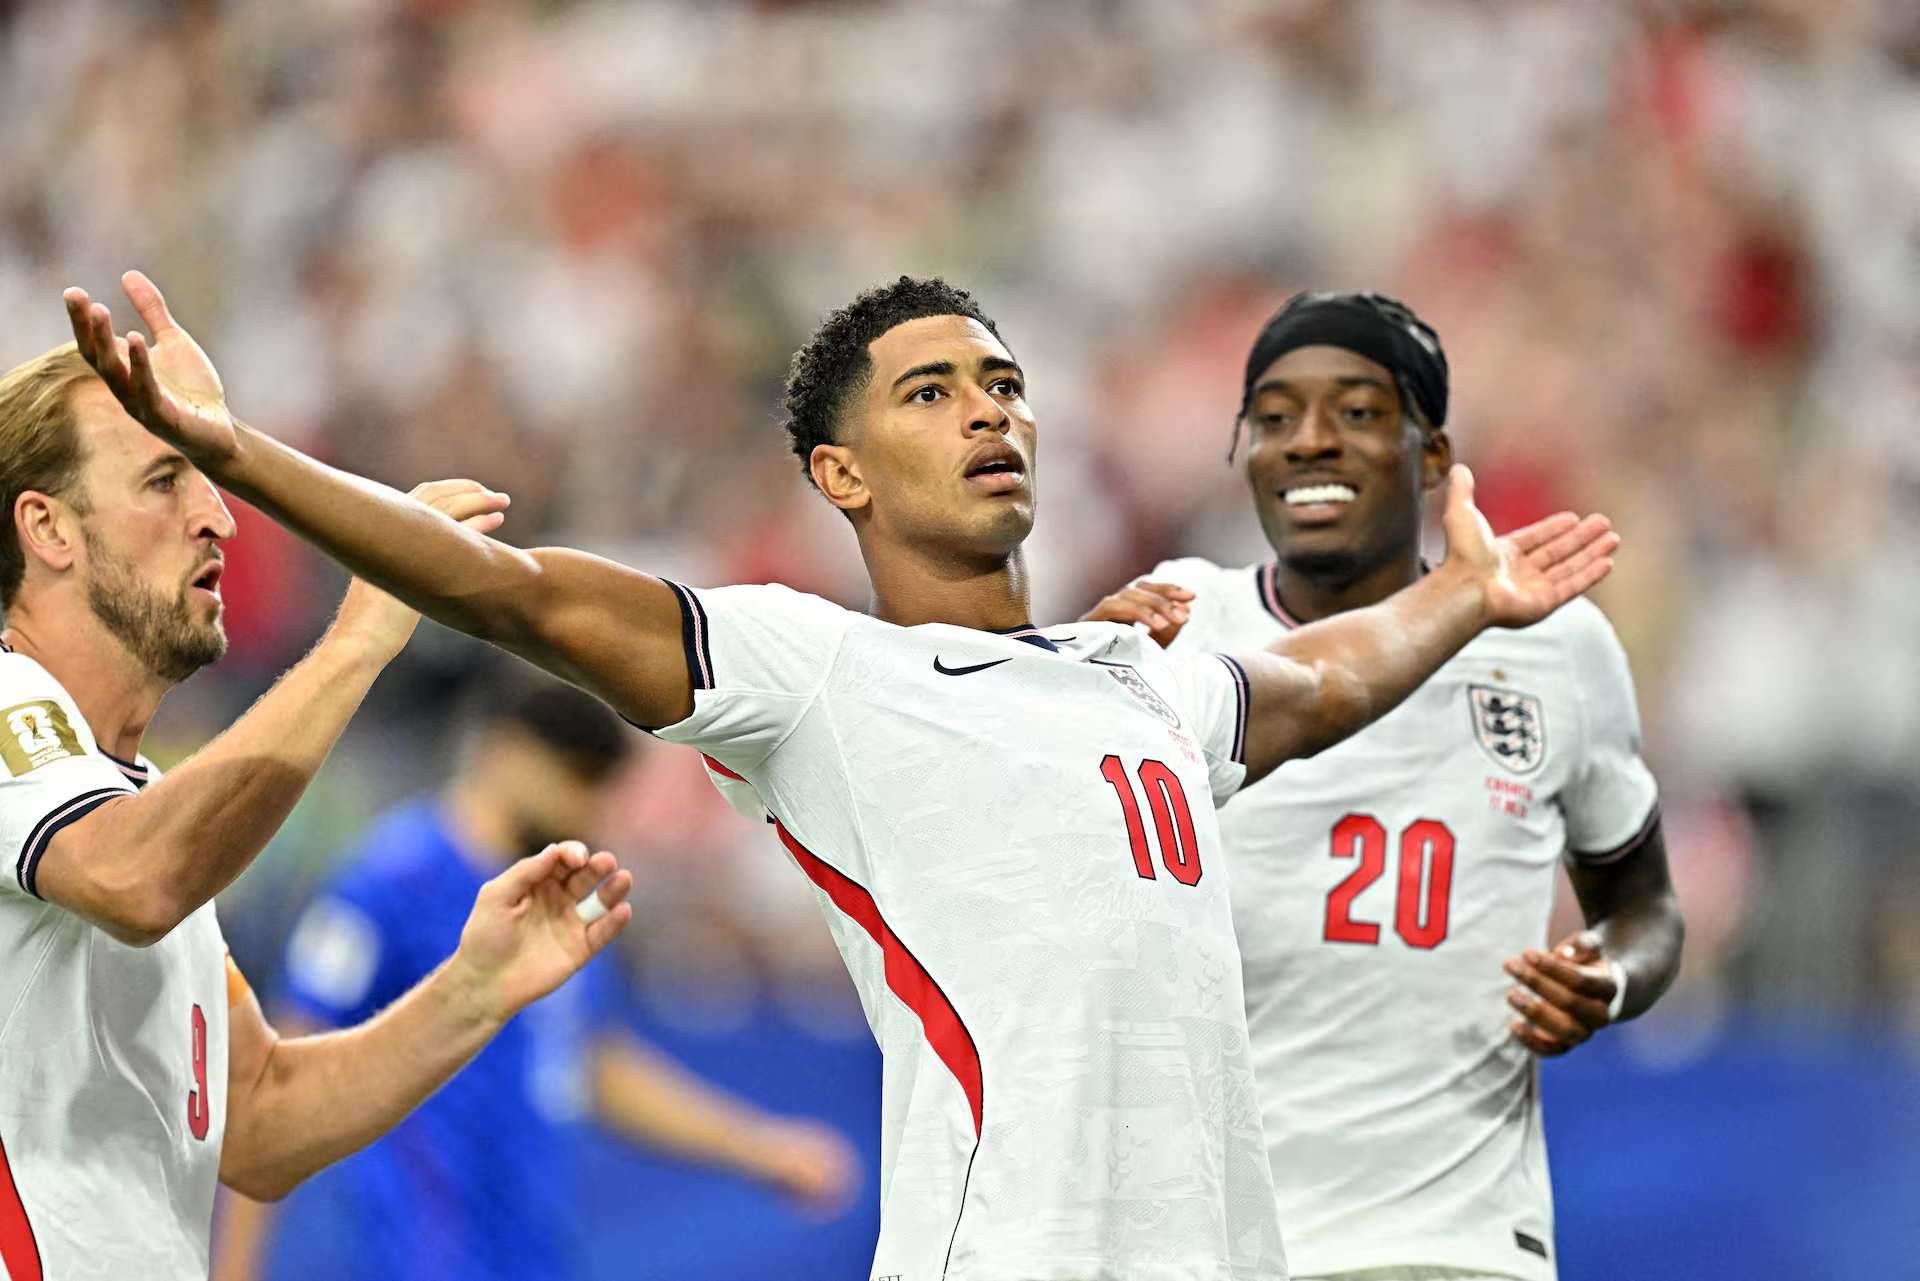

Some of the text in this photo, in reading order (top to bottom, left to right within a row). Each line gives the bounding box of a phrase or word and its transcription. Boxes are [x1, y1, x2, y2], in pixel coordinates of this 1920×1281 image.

[1100, 754, 1203, 887] 10
[1323, 811, 1456, 952] 20
[188, 1003, 209, 1141] 9
